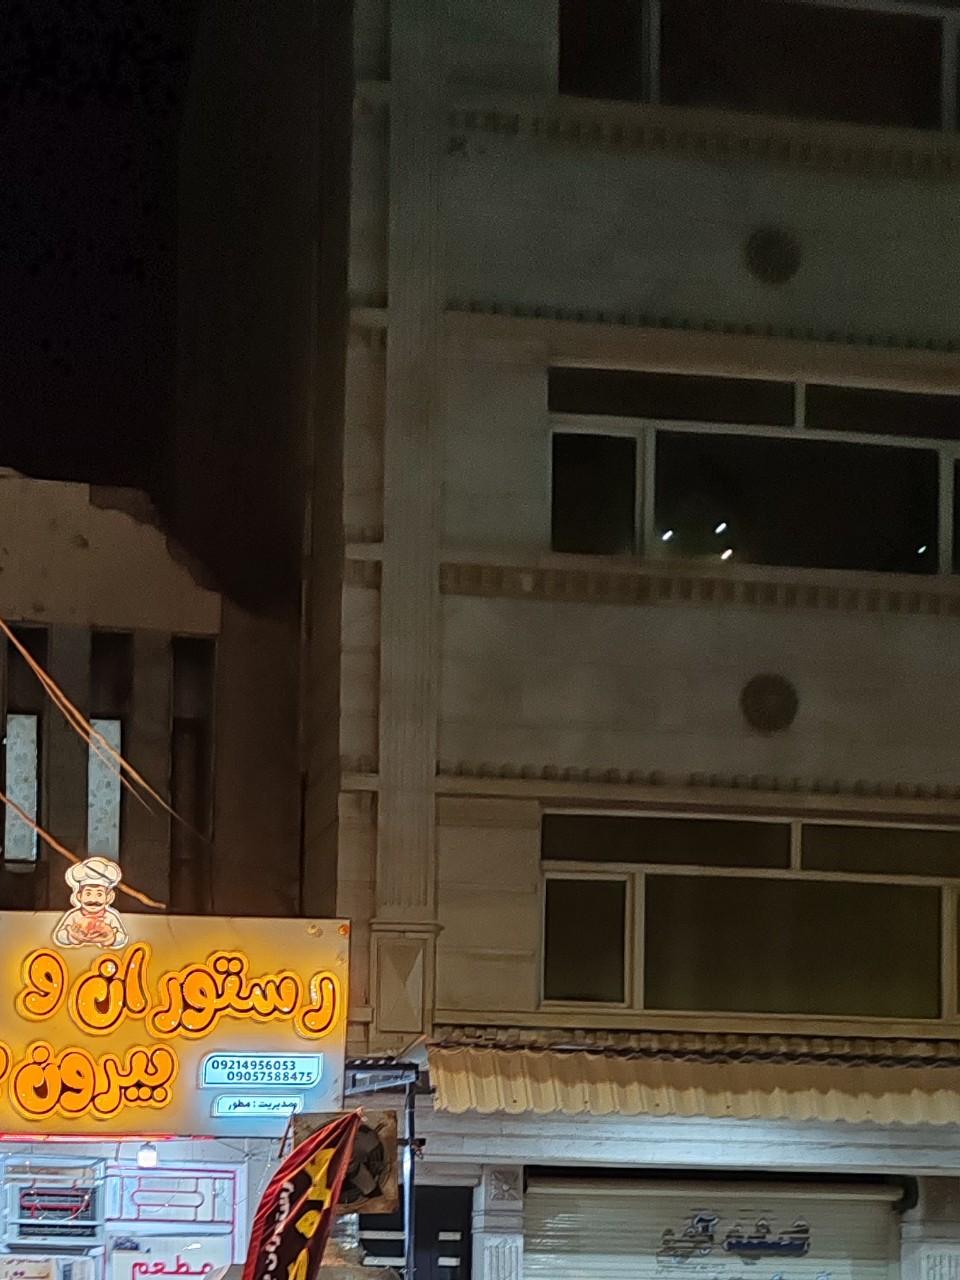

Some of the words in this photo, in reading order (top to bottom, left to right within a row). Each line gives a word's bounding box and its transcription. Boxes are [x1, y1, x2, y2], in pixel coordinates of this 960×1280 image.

[19, 951, 67, 1019] و
[71, 945, 337, 1037] رستوران
[12, 1041, 177, 1118] بیرون
[211, 1060, 296, 1070] 09214956053
[226, 1071, 312, 1082] 09057588475
